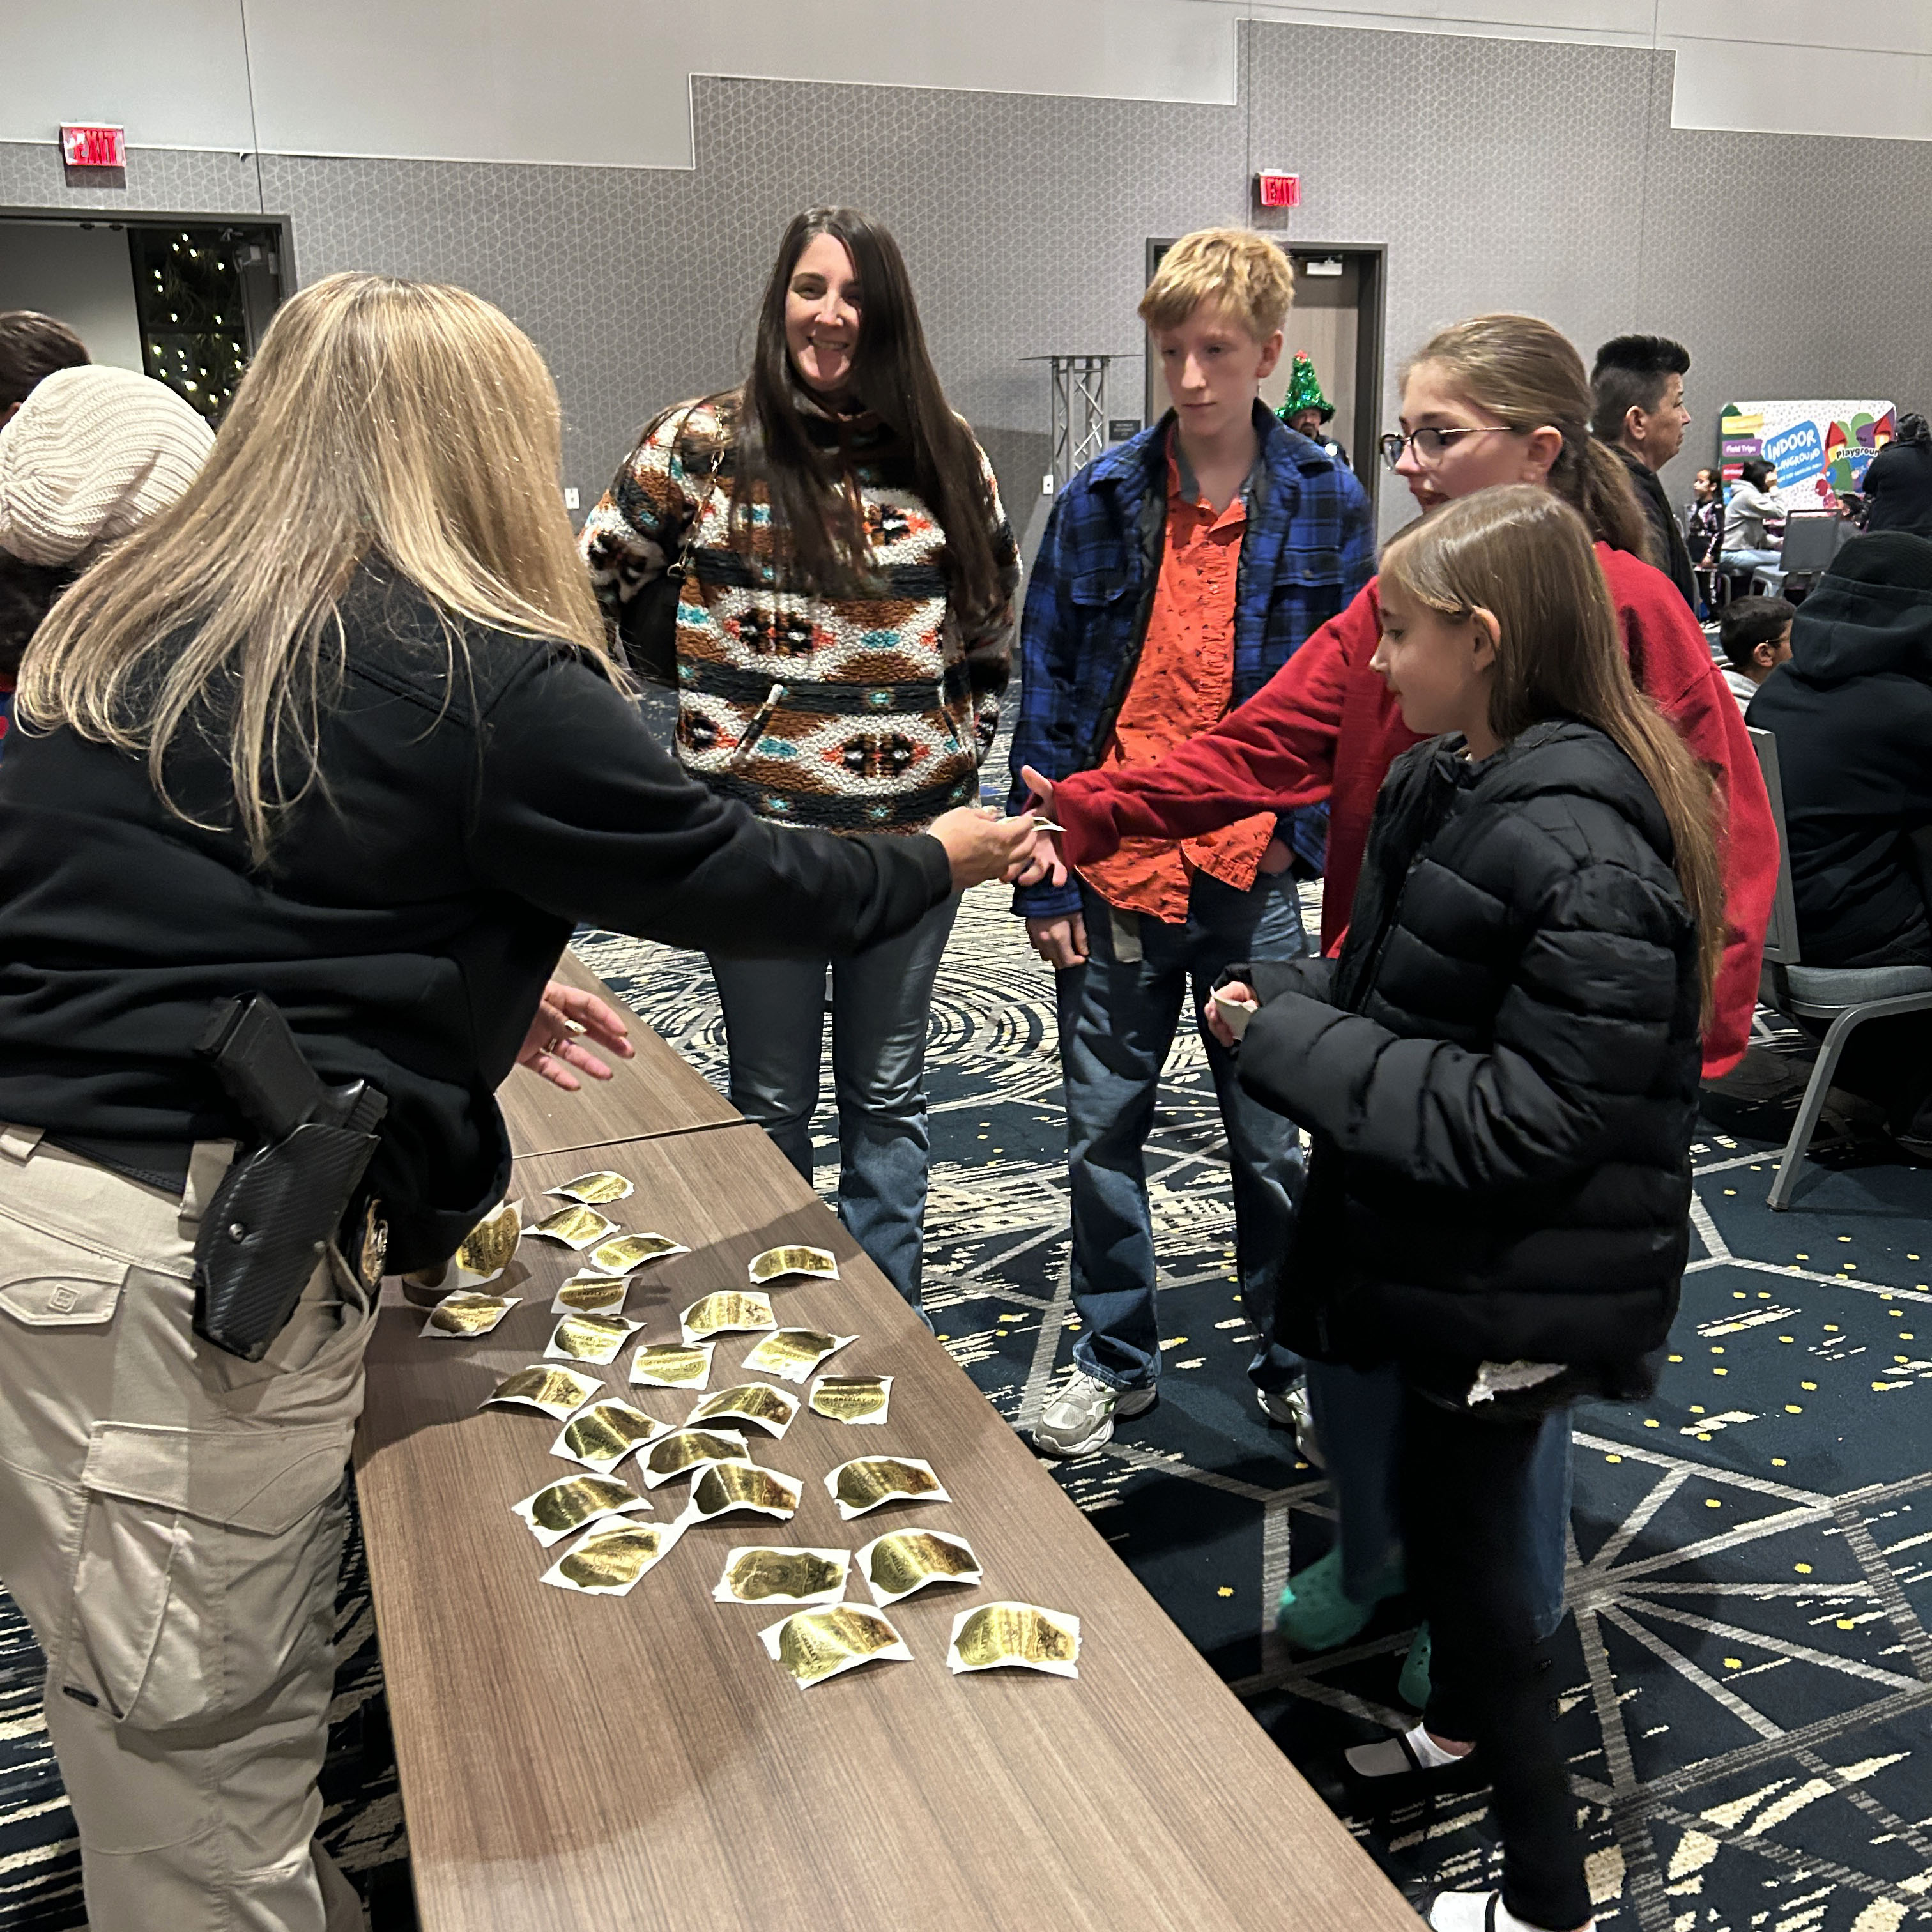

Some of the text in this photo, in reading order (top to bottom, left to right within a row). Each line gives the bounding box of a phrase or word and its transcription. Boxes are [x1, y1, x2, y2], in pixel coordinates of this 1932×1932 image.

[72, 130, 117, 164] EXIT
[1266, 178, 1295, 204] EXIT
[1741, 445, 1756, 454] Trips
[1767, 429, 1817, 461] INDOOR
[1836, 448, 1880, 459] Playgroun
[1775, 448, 1820, 471] LAYGROUND
